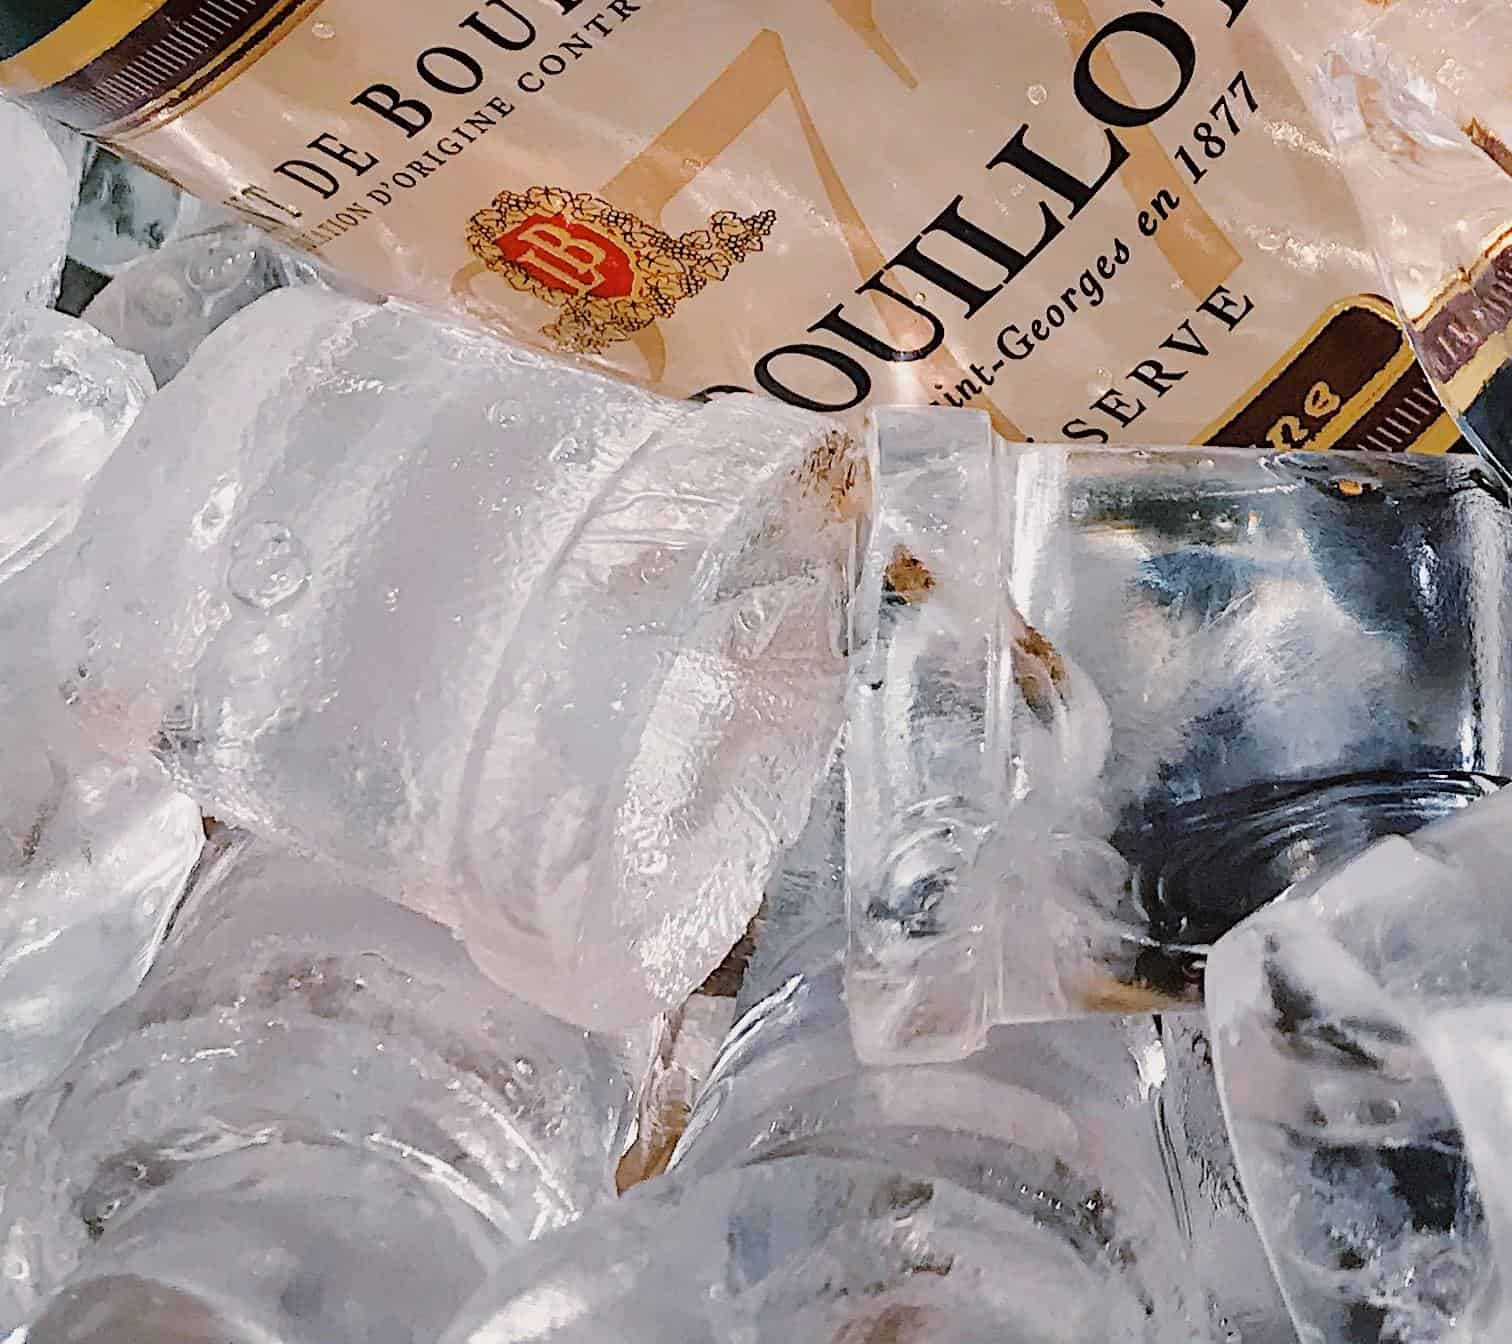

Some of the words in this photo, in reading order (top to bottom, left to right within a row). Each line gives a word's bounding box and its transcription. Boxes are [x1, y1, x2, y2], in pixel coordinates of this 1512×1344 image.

[273, 132, 380, 201] DE
[366, 95, 516, 206] D'ORIGINE
[929, 238, 1131, 409] int-Georges
[1137, 188, 1181, 237] en
[1174, 70, 1259, 185] 1877
[1026, 284, 1255, 444] SERVE
